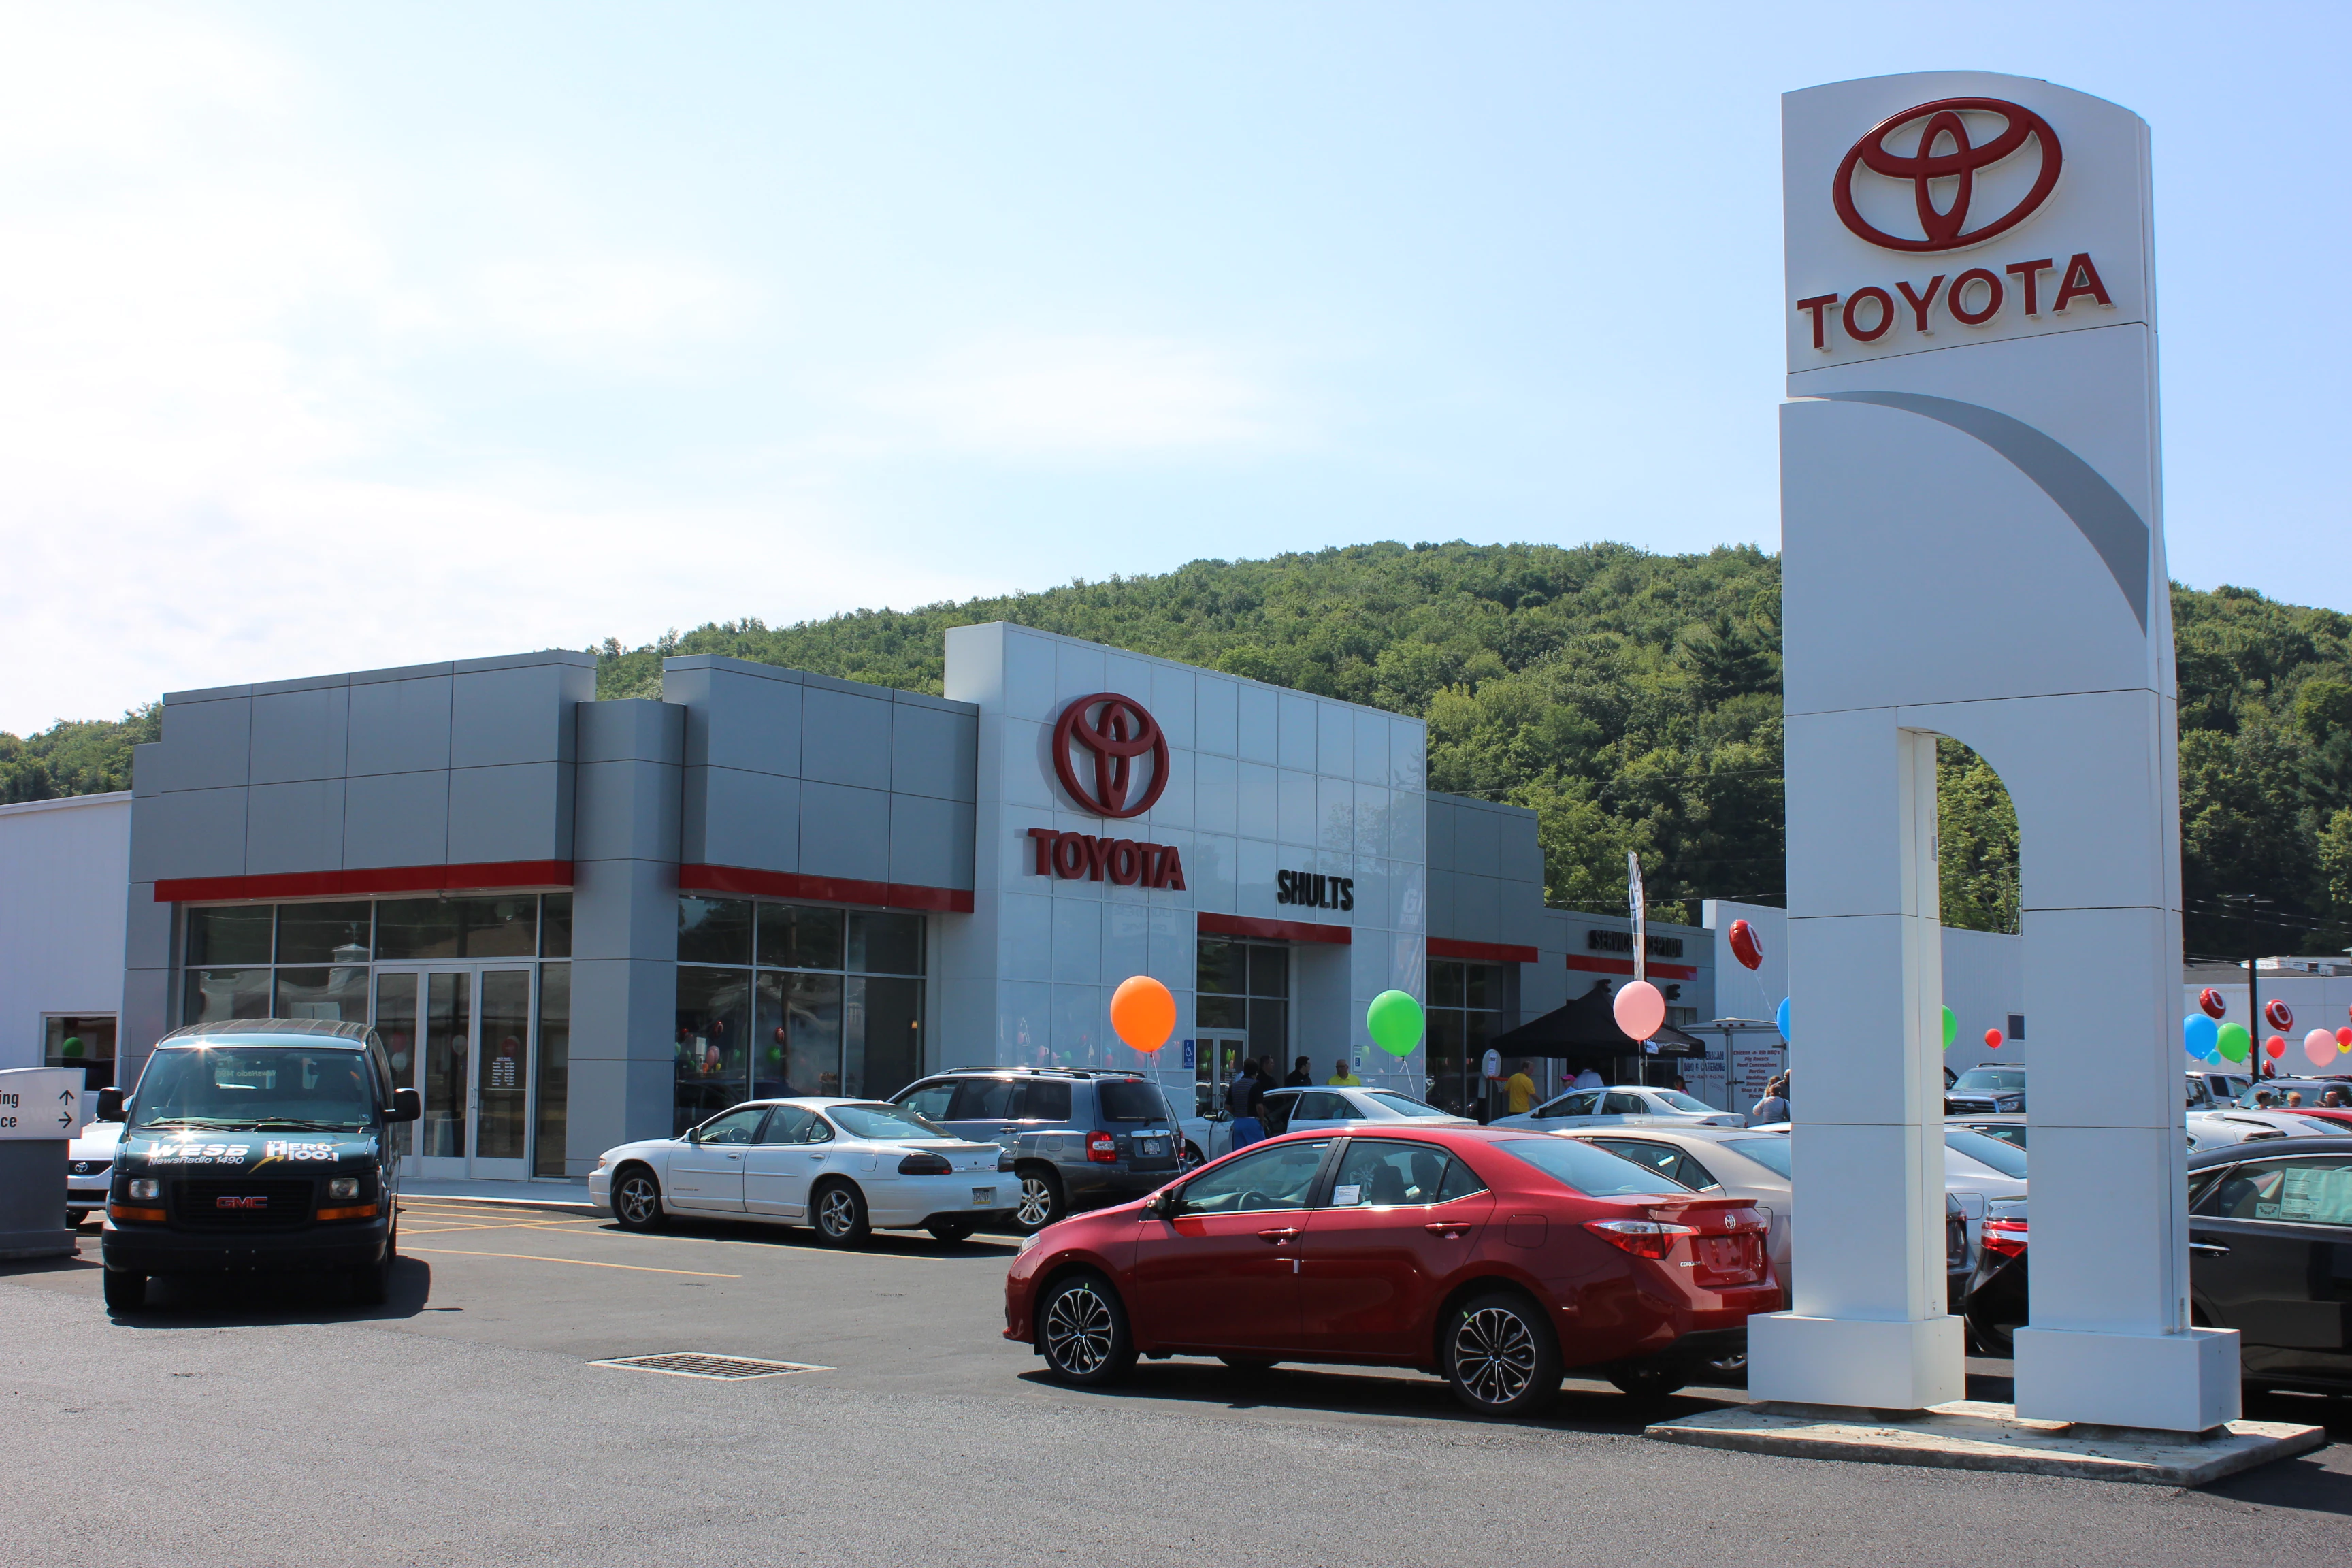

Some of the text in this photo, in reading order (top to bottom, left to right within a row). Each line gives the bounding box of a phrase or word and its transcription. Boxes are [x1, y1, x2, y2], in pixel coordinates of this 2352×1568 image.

[1797, 252, 2115, 353] TOYOTA
[1028, 828, 1186, 891] TOYOTA
[1277, 869, 1354, 911] SHULTS
[1591, 930, 1633, 951] SERVICE
[148, 1142, 333, 1158] WESB HERO
[288, 1150, 339, 1162] 100.1
[148, 1156, 244, 1166] NewsRadio 1490
[217, 1196, 268, 1208] GMC
